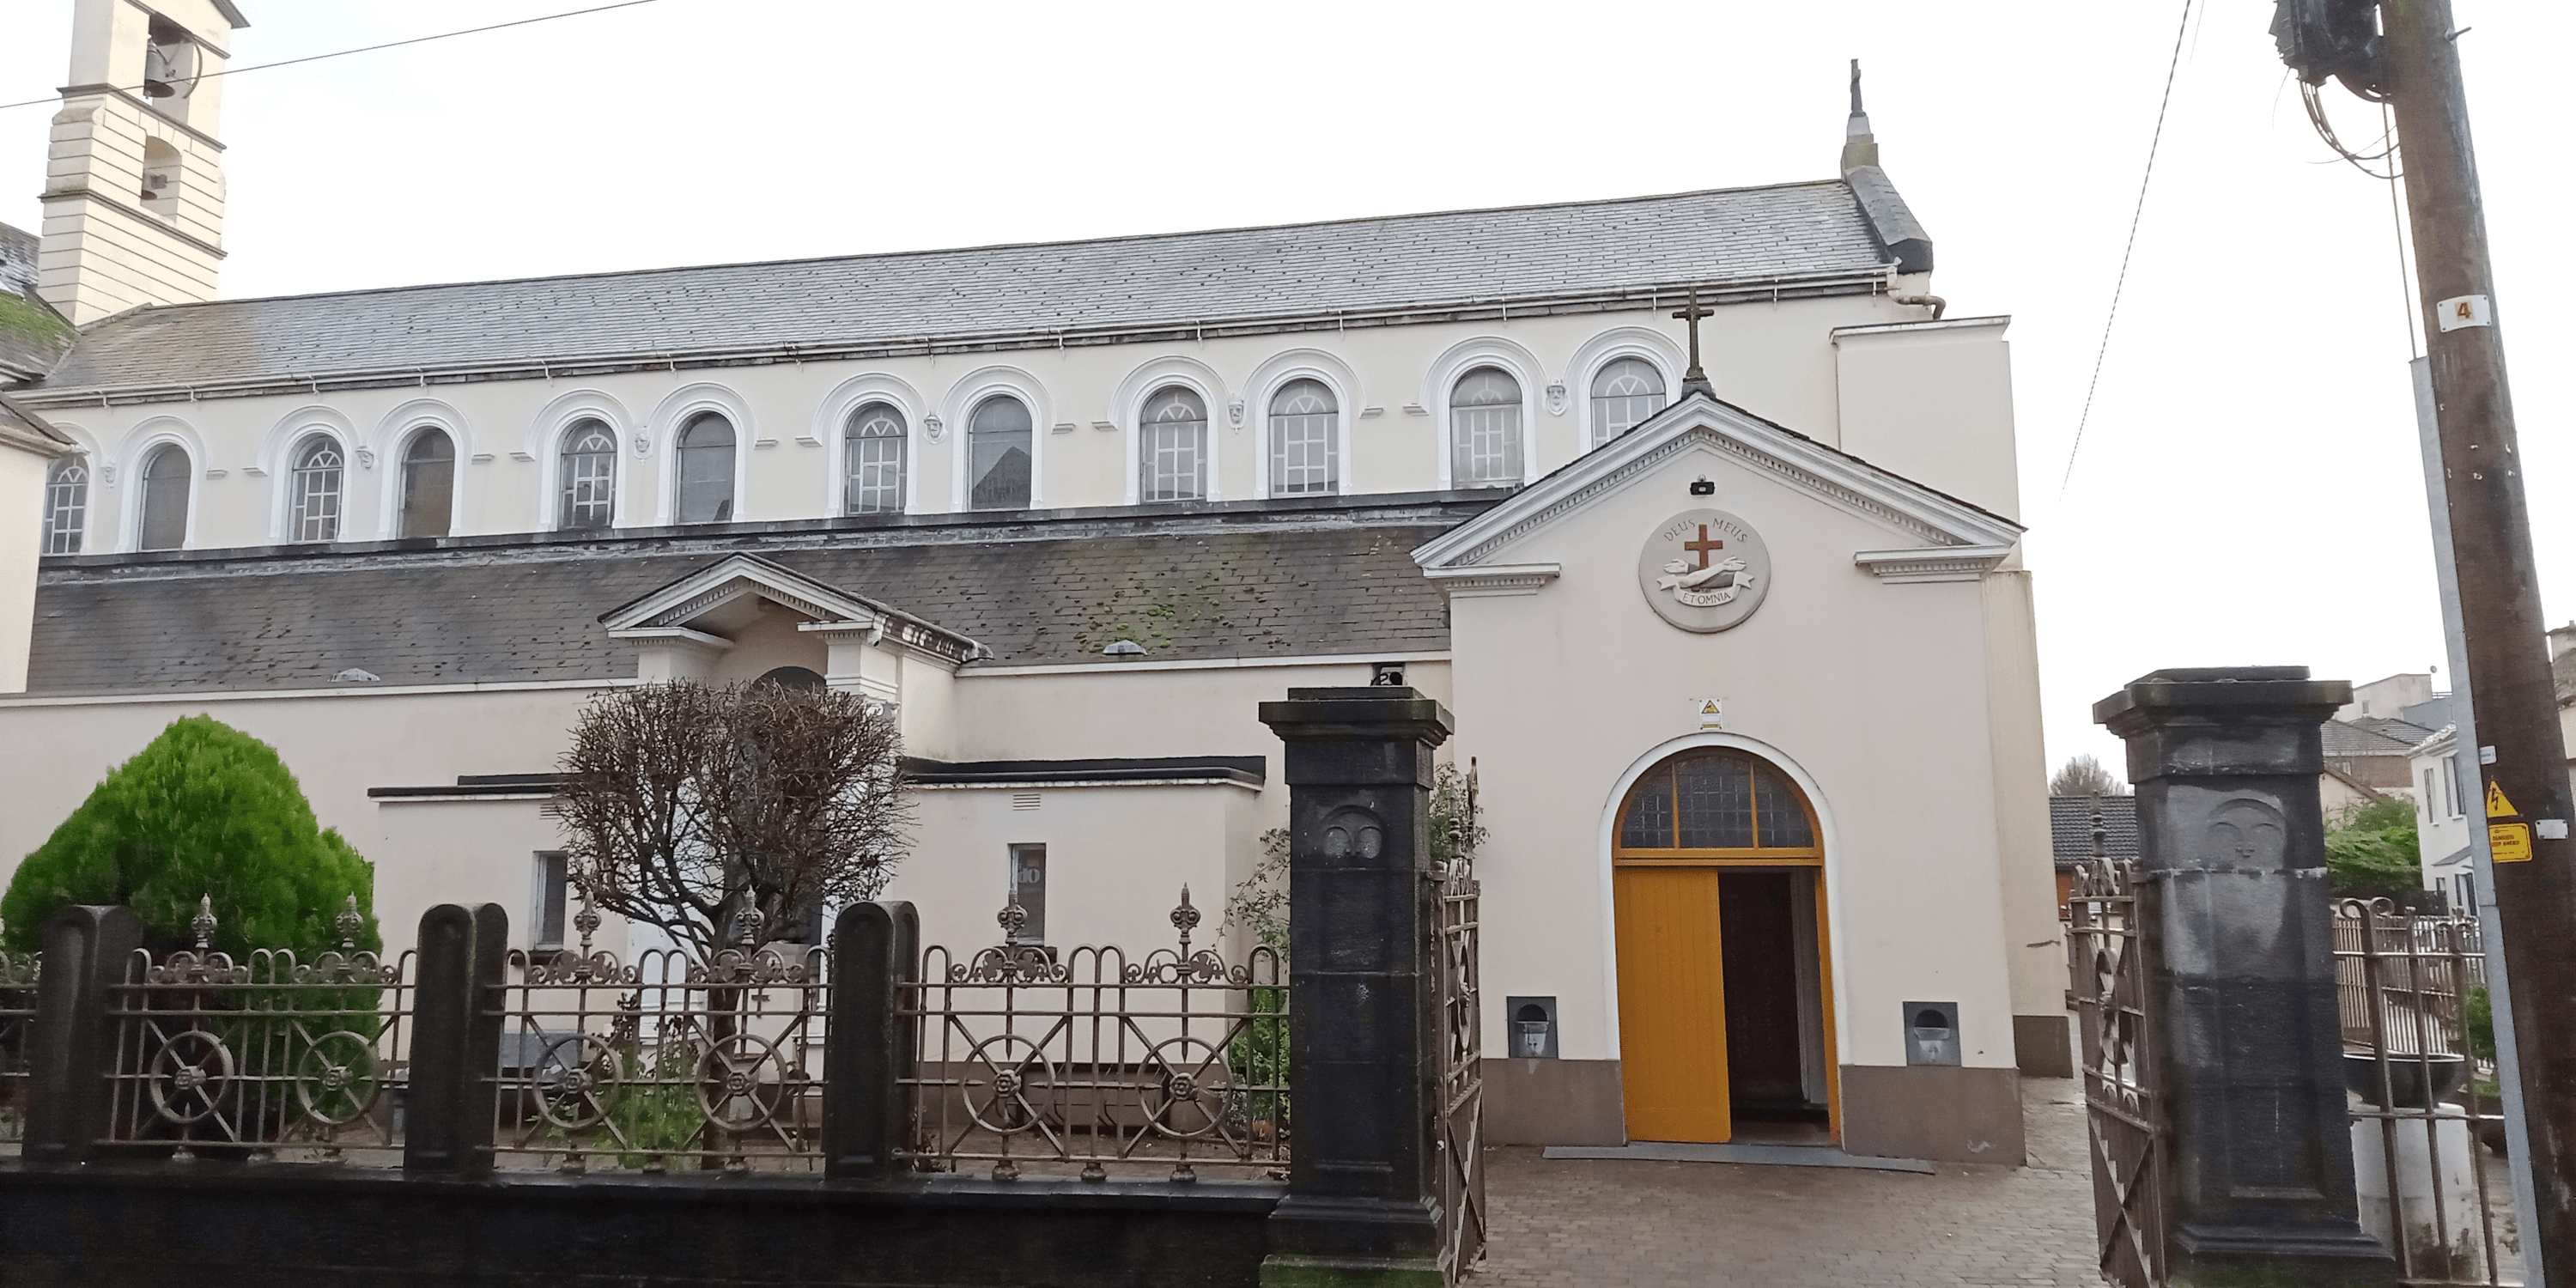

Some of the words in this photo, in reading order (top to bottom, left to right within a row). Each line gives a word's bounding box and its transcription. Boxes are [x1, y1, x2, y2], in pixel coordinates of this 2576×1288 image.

[2458, 302, 2471, 319] 4
[1663, 519, 1696, 542] DEUS
[1712, 518, 1747, 543] MEUS
